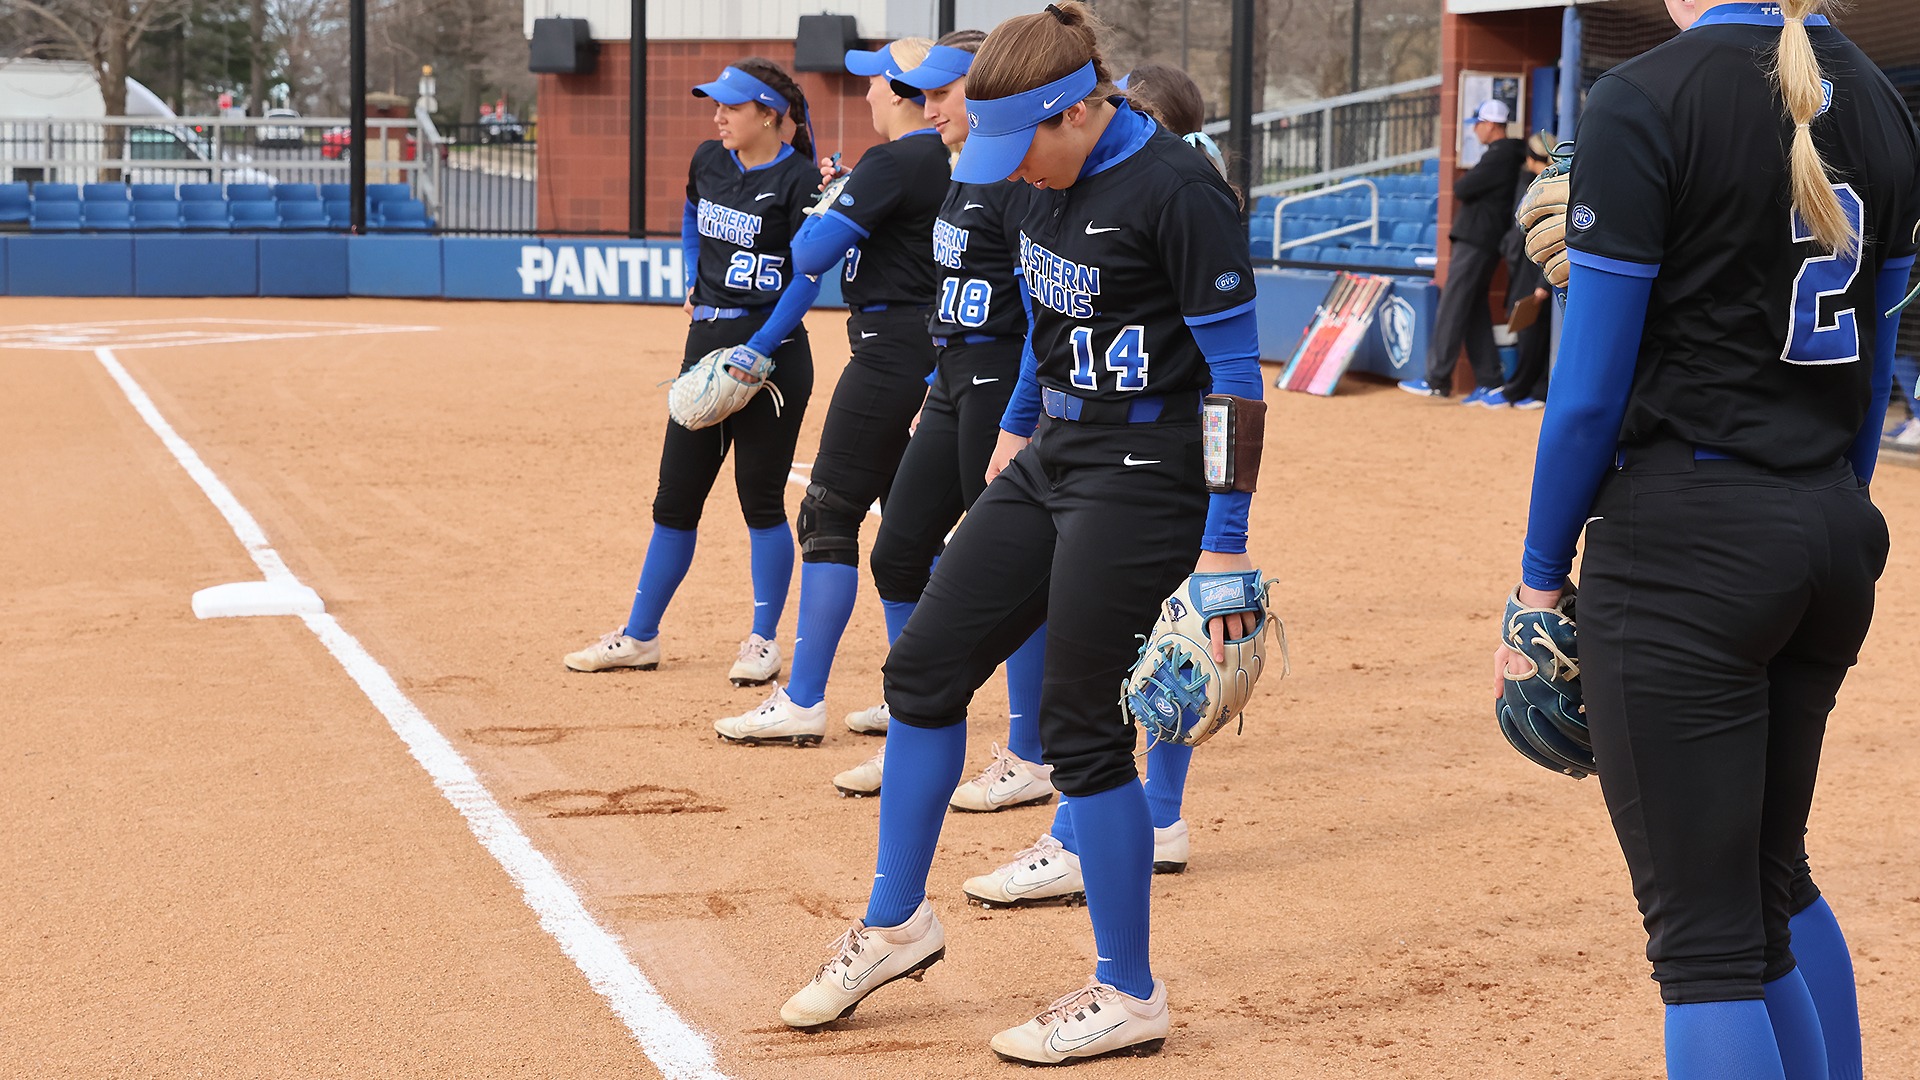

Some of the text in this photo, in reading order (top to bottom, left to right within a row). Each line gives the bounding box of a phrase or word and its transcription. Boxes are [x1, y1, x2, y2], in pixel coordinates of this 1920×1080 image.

[698, 198, 762, 234] EASTERN
[933, 217, 970, 252] STERN
[516, 245, 687, 298] PANTH
[725, 250, 785, 291] 25
[1023, 265, 1094, 319] LINOIS
[1780, 183, 1864, 366] 2
[939, 276, 993, 327] 18
[1069, 325, 1149, 391] 14
